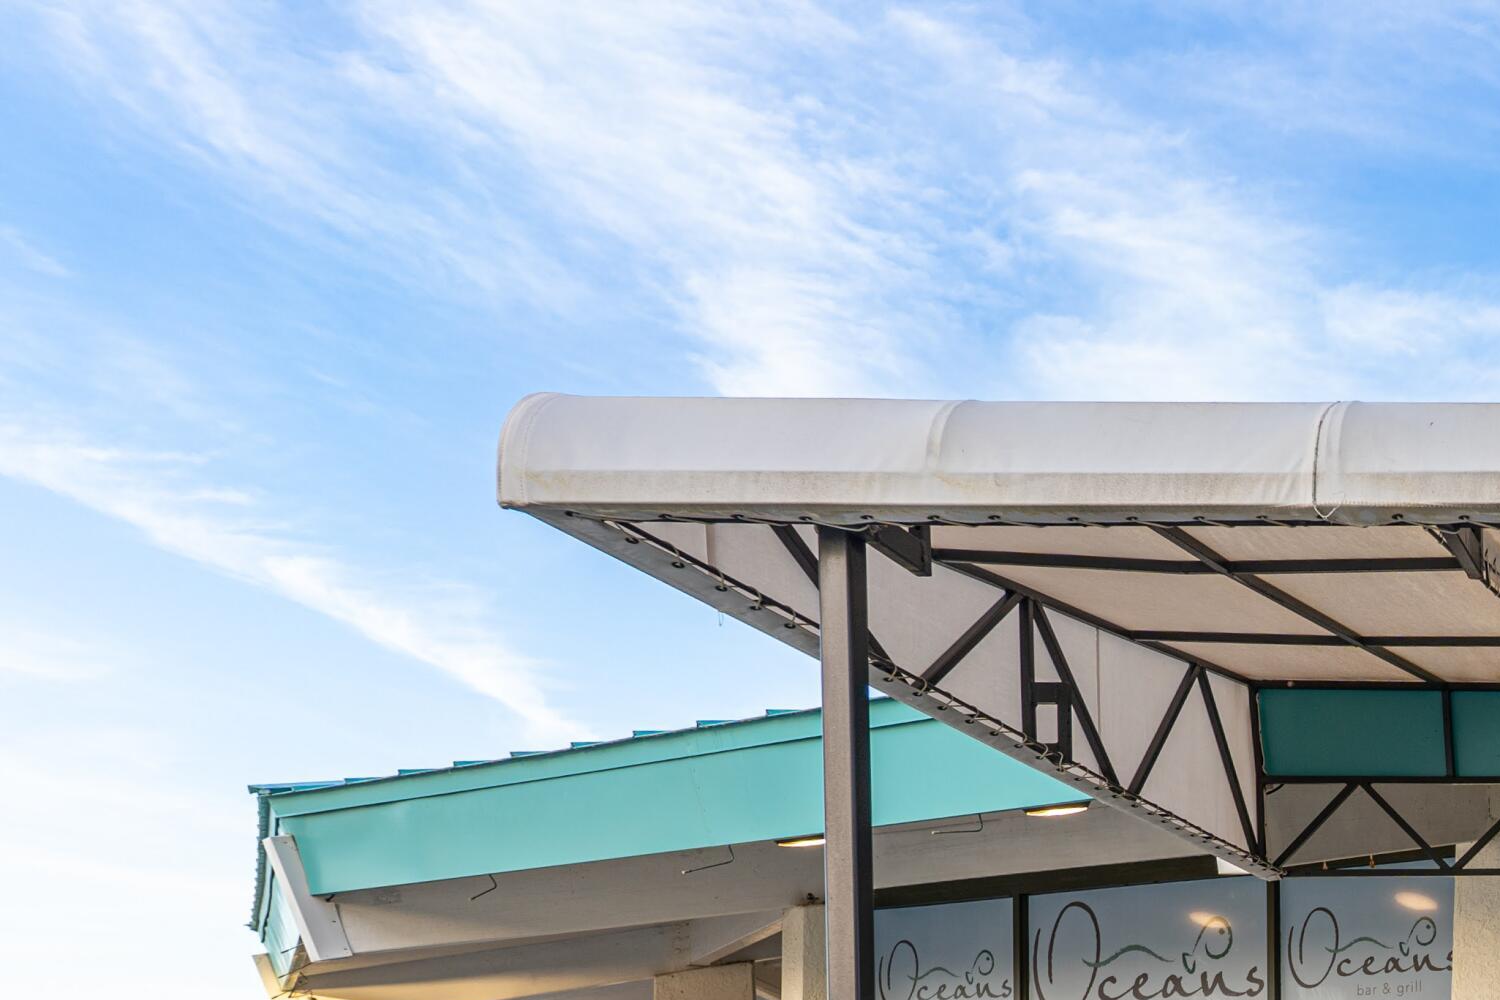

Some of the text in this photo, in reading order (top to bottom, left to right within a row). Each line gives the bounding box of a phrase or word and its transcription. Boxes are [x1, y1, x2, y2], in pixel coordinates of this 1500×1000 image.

[1357, 982, 1422, 996] bar & grill
